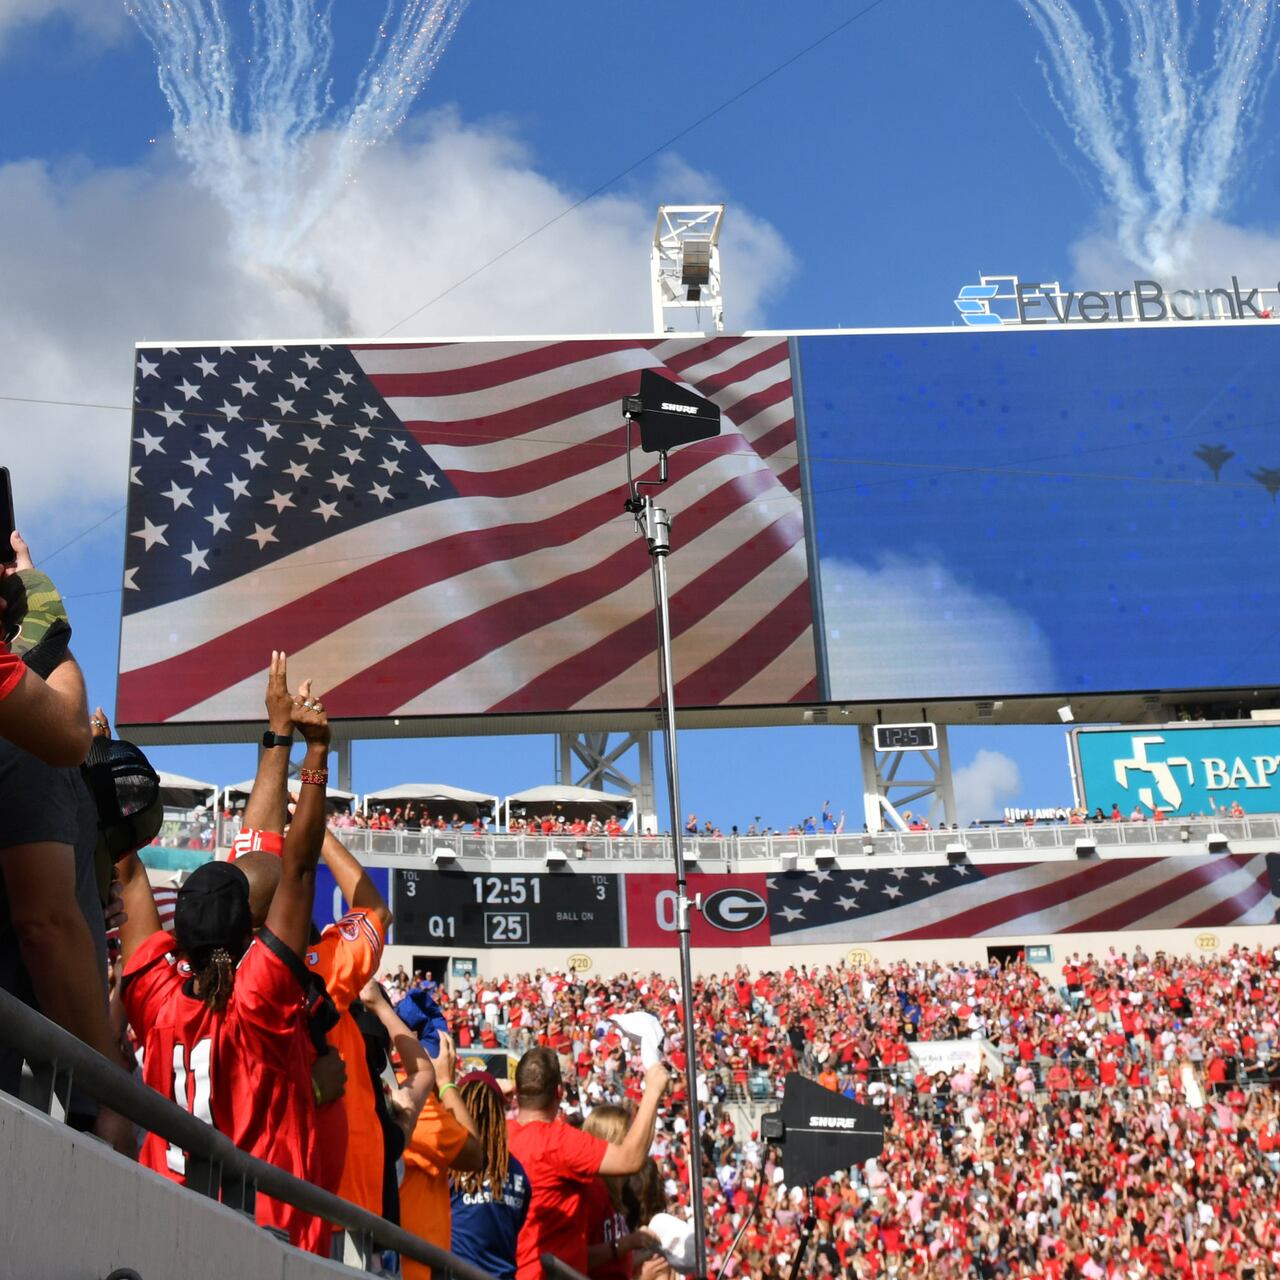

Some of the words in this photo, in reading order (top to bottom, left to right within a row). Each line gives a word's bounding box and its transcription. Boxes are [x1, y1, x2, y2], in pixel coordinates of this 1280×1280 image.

[1017, 276, 1260, 324] EverBank
[661, 402, 699, 415] SHURE
[402, 871, 420, 881] TOL
[592, 875, 609, 885] TOL
[406, 882, 416, 897] 3
[473, 877, 541, 904] 12:51
[596, 886, 606, 901] 3
[556, 912, 576, 921] BALL
[581, 912, 594, 921] ON
[655, 890, 679, 932] 0
[428, 916, 455, 938] Q1
[492, 916, 523, 940] 25
[571, 958, 589, 968] 220
[809, 1116, 857, 1129] SHURE
